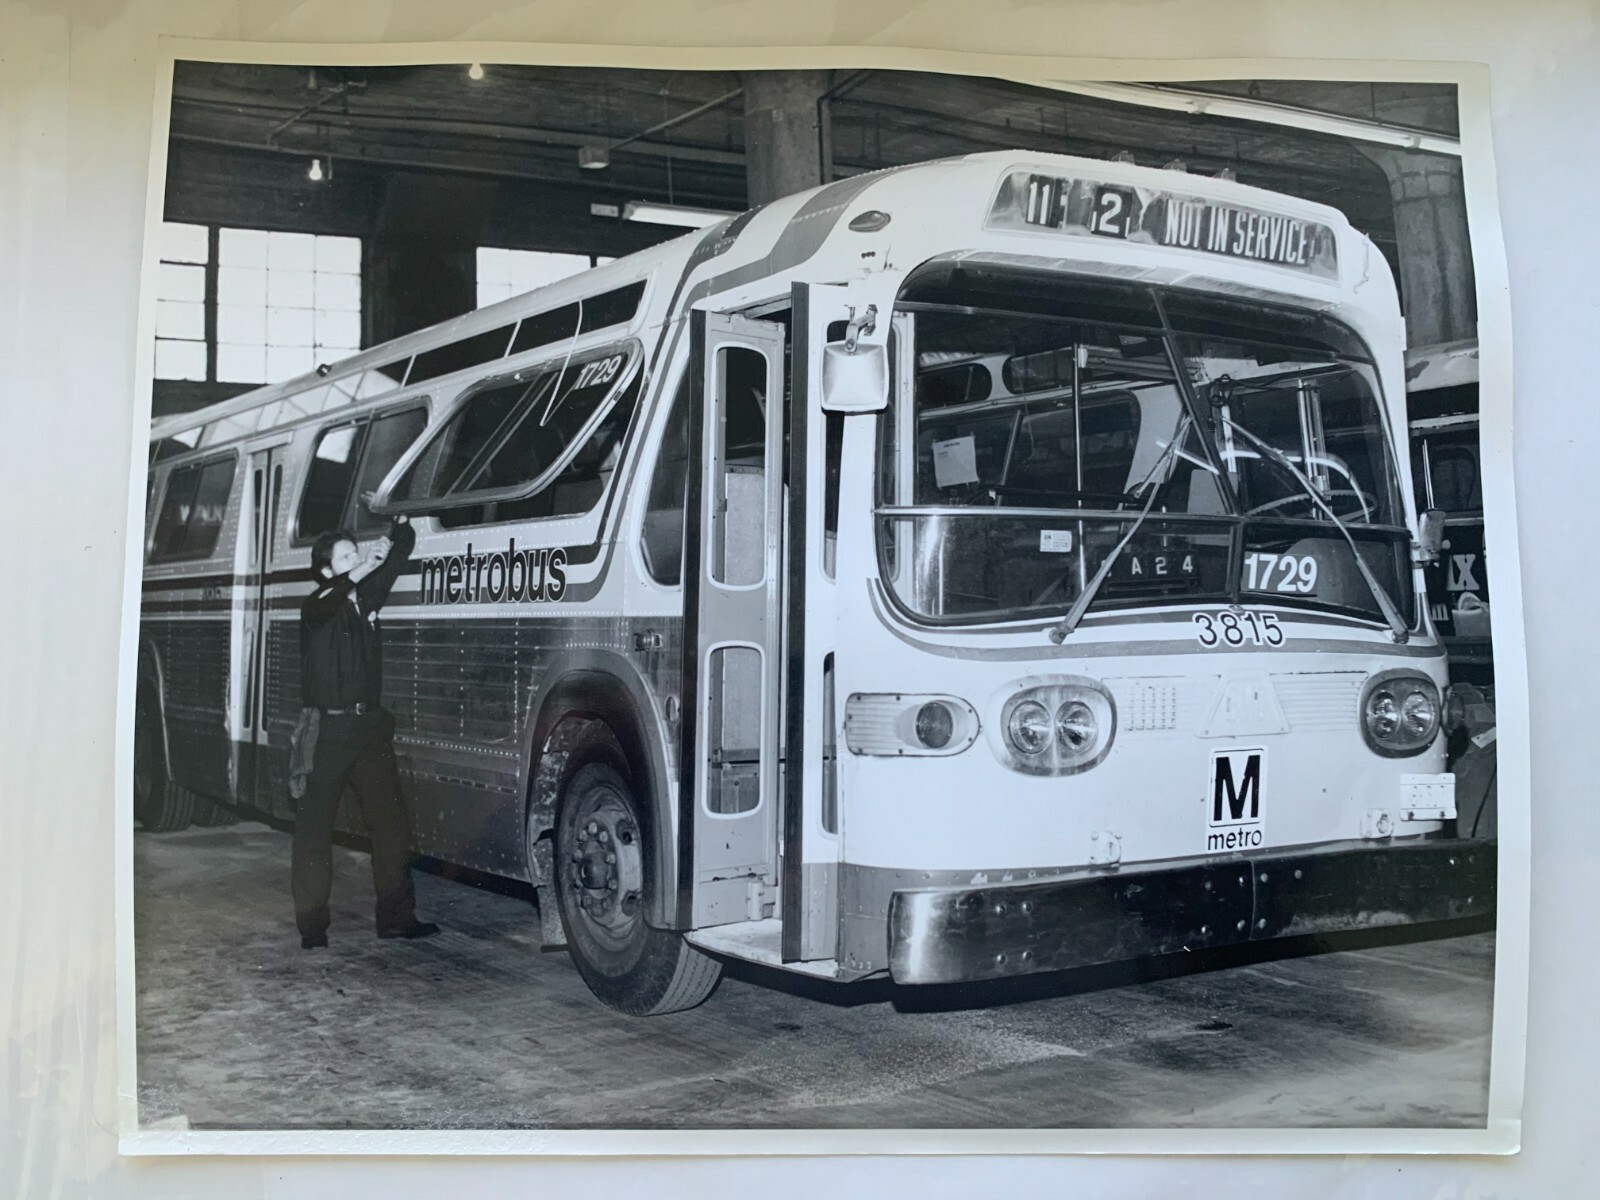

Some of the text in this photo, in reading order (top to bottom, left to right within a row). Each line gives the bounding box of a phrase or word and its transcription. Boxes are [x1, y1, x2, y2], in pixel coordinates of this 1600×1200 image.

[1165, 199, 1206, 248] NOT
[1208, 206, 1229, 252] IN
[1233, 211, 1307, 265] SERVICE
[575, 354, 622, 390] 1729
[421, 537, 568, 604] metrobus
[1245, 553, 1318, 593] 1729
[1193, 612, 1285, 647] 3815
[1213, 754, 1261, 822] M
[1207, 827, 1262, 851] metro
